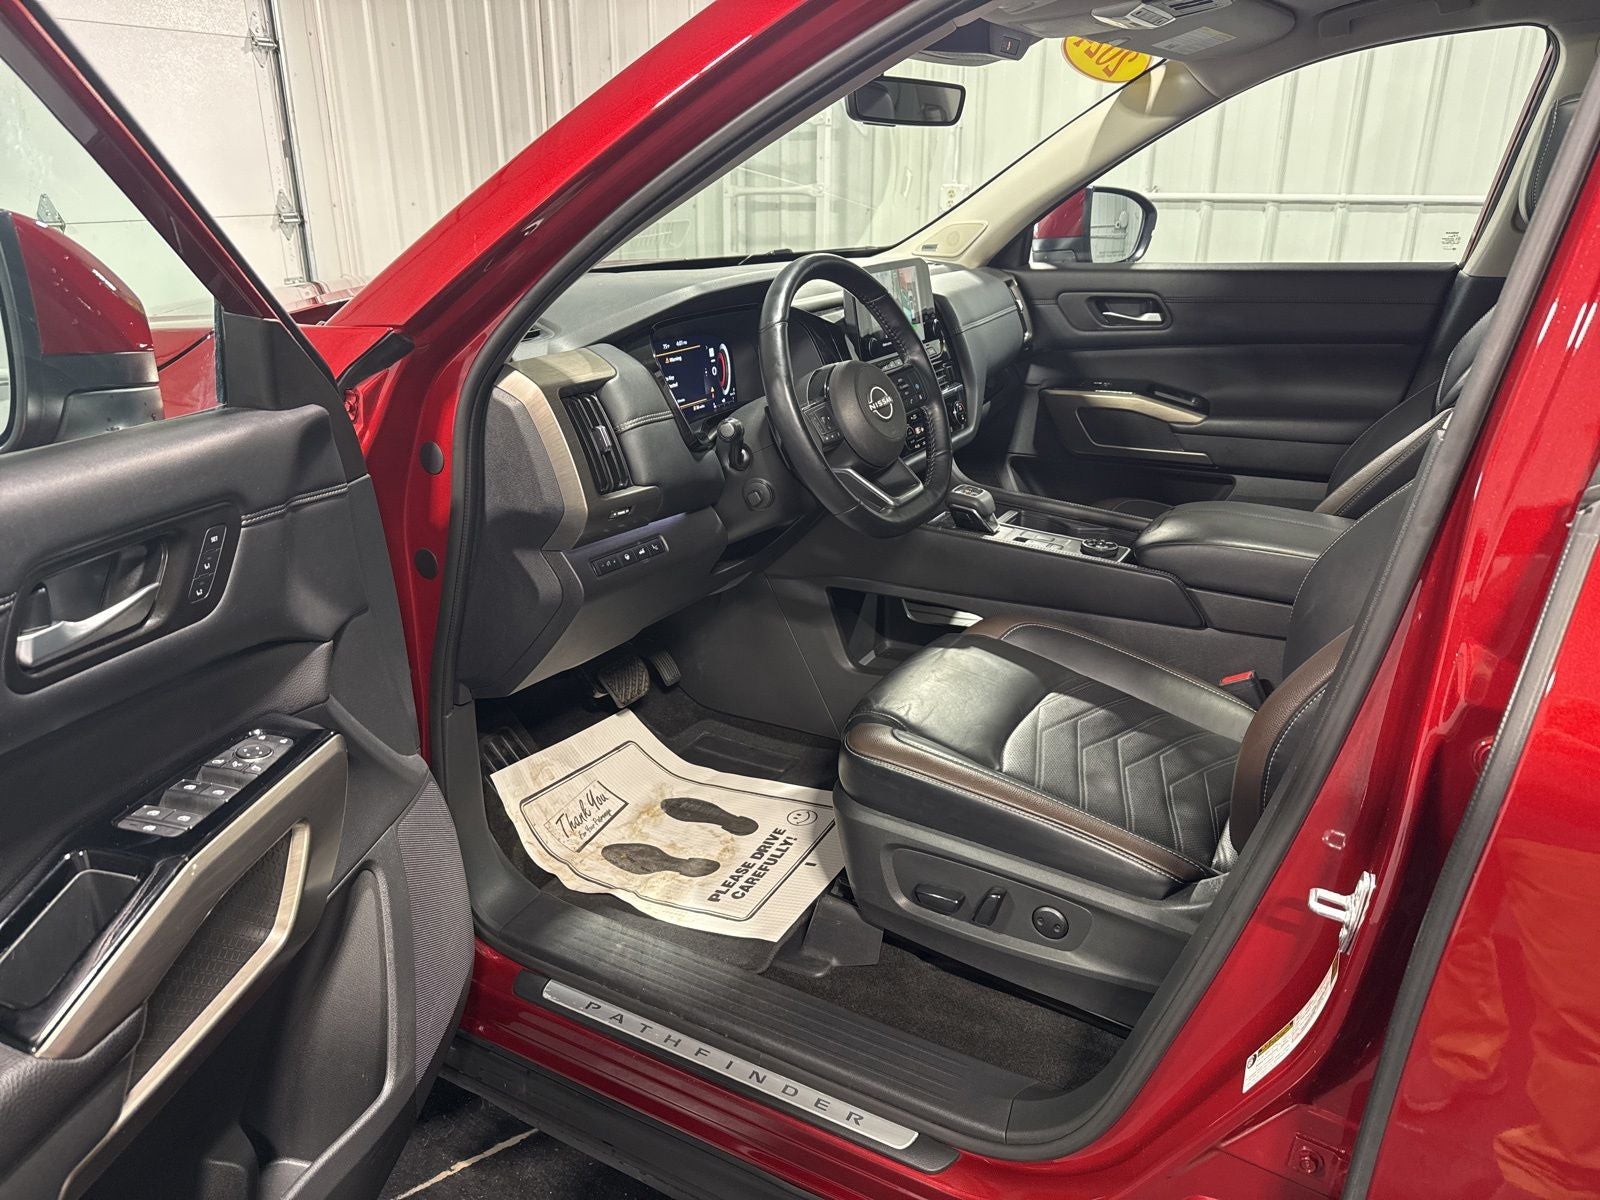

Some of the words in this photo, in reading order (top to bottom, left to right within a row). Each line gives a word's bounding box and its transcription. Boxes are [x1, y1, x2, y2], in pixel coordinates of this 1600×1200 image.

[556, 799, 592, 838] Thank
[586, 789, 609, 810] You
[707, 861, 756, 902] PLEASE
[750, 827, 786, 860] DRIVE
[731, 836, 797, 900] CAREFULLY!
[585, 1001, 865, 1126] PATHFINDER
